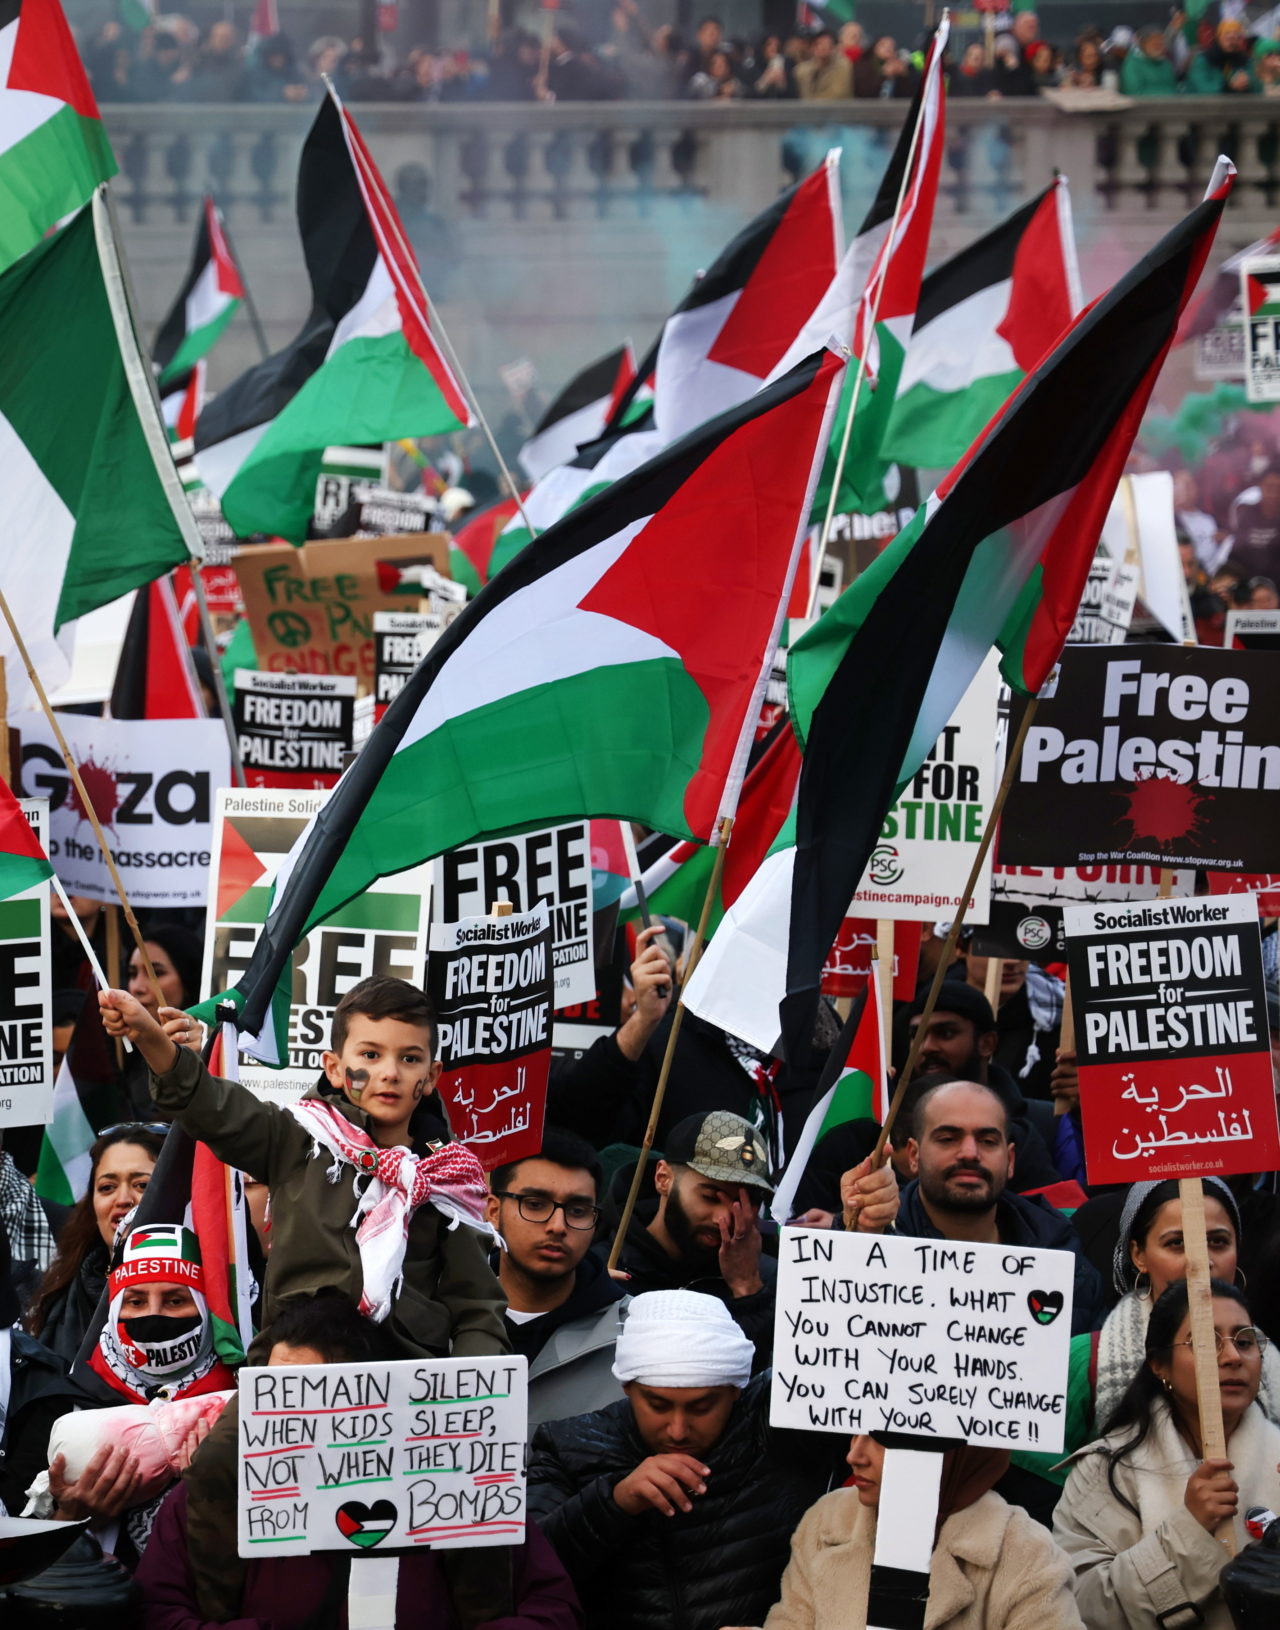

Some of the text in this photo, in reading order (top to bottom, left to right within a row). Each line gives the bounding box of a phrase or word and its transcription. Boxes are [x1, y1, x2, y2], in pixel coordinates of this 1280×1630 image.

[264, 564, 361, 603] FREE
[243, 694, 342, 728] FREEDOM
[1103, 660, 1250, 724] Free
[238, 738, 345, 769] PALESTINE
[913, 763, 980, 802] FOR
[225, 797, 295, 814] Palestine
[879, 801, 983, 842] STINE
[65, 837, 94, 861] the
[871, 858, 897, 873] PSC
[1078, 851, 1244, 869] Stop the War Coalition www.stopwar.org.uk
[443, 825, 588, 924] FREE
[1024, 926, 1044, 940] PSC
[444, 941, 547, 1000] FREEDOM
[553, 943, 588, 967] PATION
[1087, 934, 1242, 987] FREEDOM
[489, 994, 510, 1014] for
[1157, 983, 1185, 1003] for
[434, 1001, 549, 1061] PALESTINE
[1085, 1001, 1258, 1055] PALESTINE
[452, 1066, 526, 1113] الحرية
[1121, 1066, 1233, 1113] الحرية
[1112, 1108, 1253, 1160] لفلسطين
[1148, 1159, 1224, 1174] socialistworker.co.uk
[114, 1259, 200, 1284] PALESTINE
[790, 1235, 1036, 1276] IN A TIME OF
[800, 1276, 1016, 1312] INJUSTICE. WHAT
[785, 1309, 1028, 1346] YOU CANNOT CHANGE
[794, 1344, 1024, 1382] WITH YOUR HANDS.
[255, 1368, 518, 1410] REMAIN SILENT
[778, 1371, 1065, 1414] YOU CAN SURELY CHANGE
[243, 1406, 497, 1447] WHEN KIDS SLEEP,
[808, 1404, 861, 1428] WITH
[879, 1407, 937, 1433] YOUR
[245, 1455, 305, 1491] NOT
[318, 1447, 394, 1486] WHEN
[404, 1442, 461, 1470] THEY
[246, 1479, 523, 1537] FROM BOMBS
